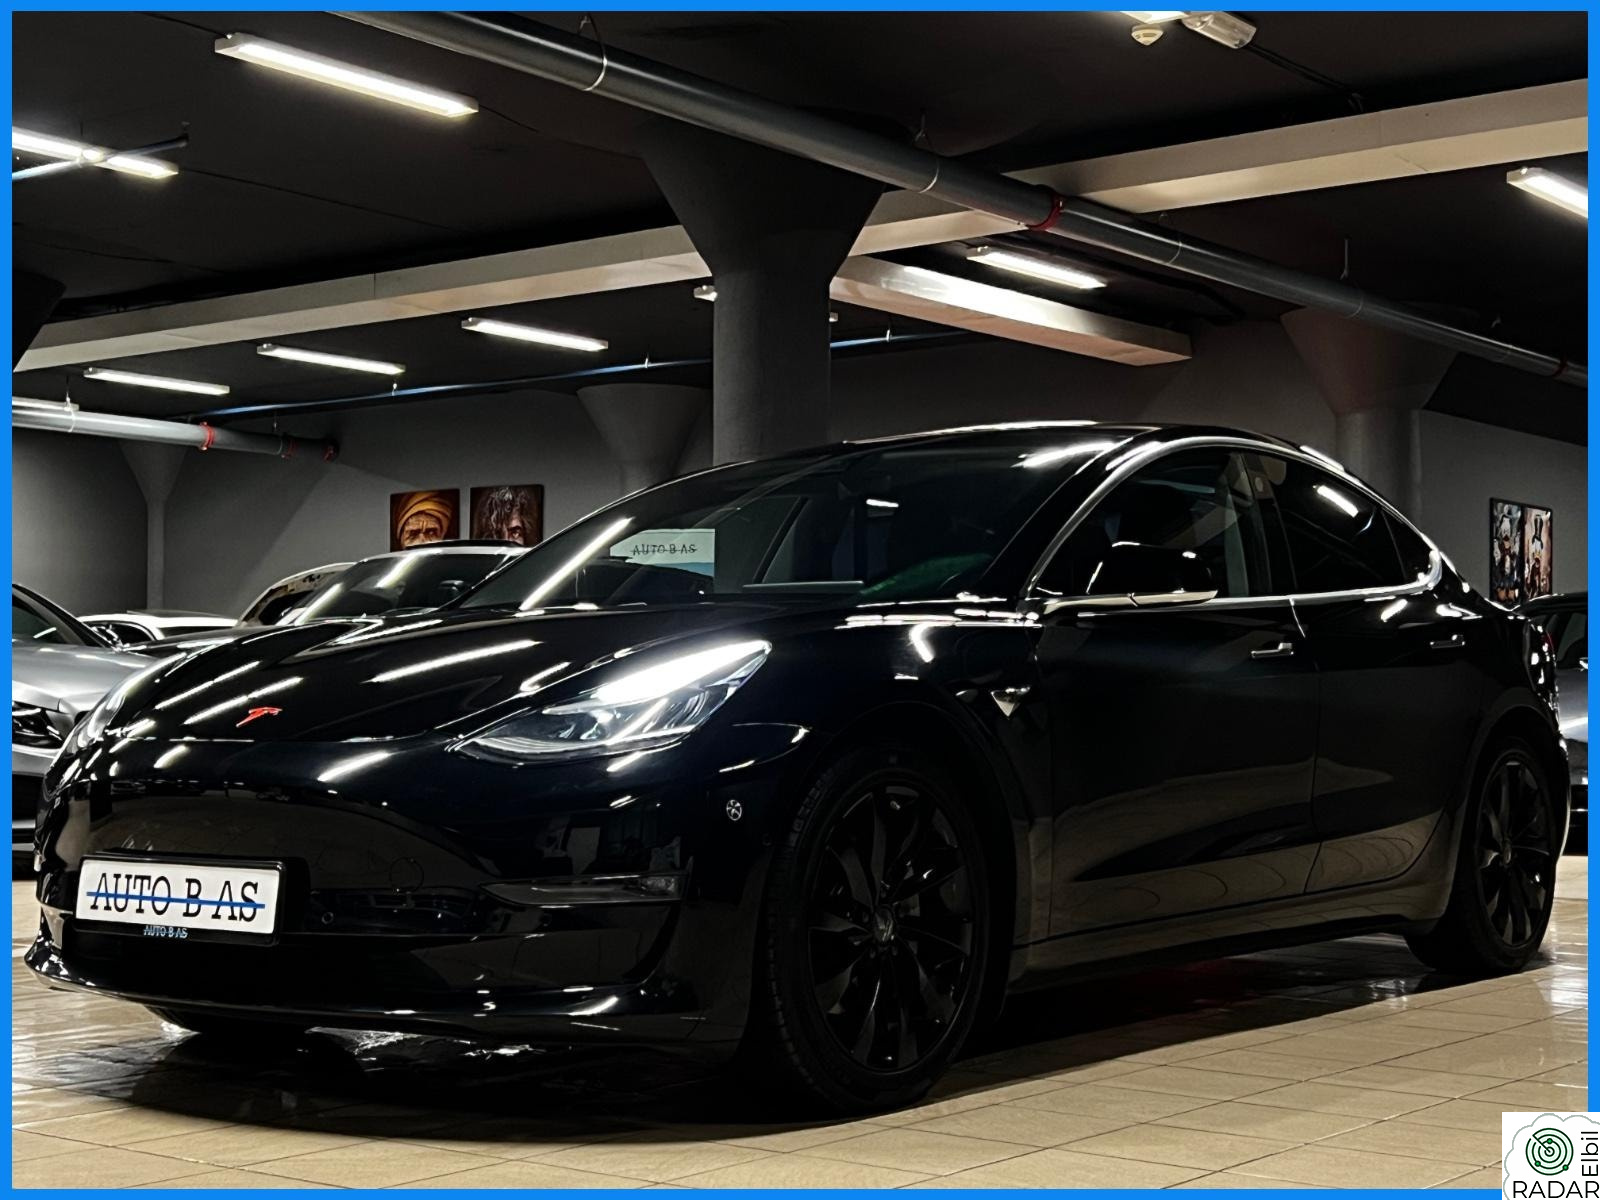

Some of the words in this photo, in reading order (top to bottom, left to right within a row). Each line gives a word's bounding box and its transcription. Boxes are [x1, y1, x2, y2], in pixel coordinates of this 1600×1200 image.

[632, 543, 665, 556] AUTO
[669, 544, 677, 554] B
[680, 543, 697, 554] AS
[90, 872, 172, 916] AUTO
[182, 877, 202, 918] B
[211, 880, 259, 923] AS
[143, 925, 166, 937] AUTO
[168, 926, 174, 938] B
[175, 927, 188, 939] AS
